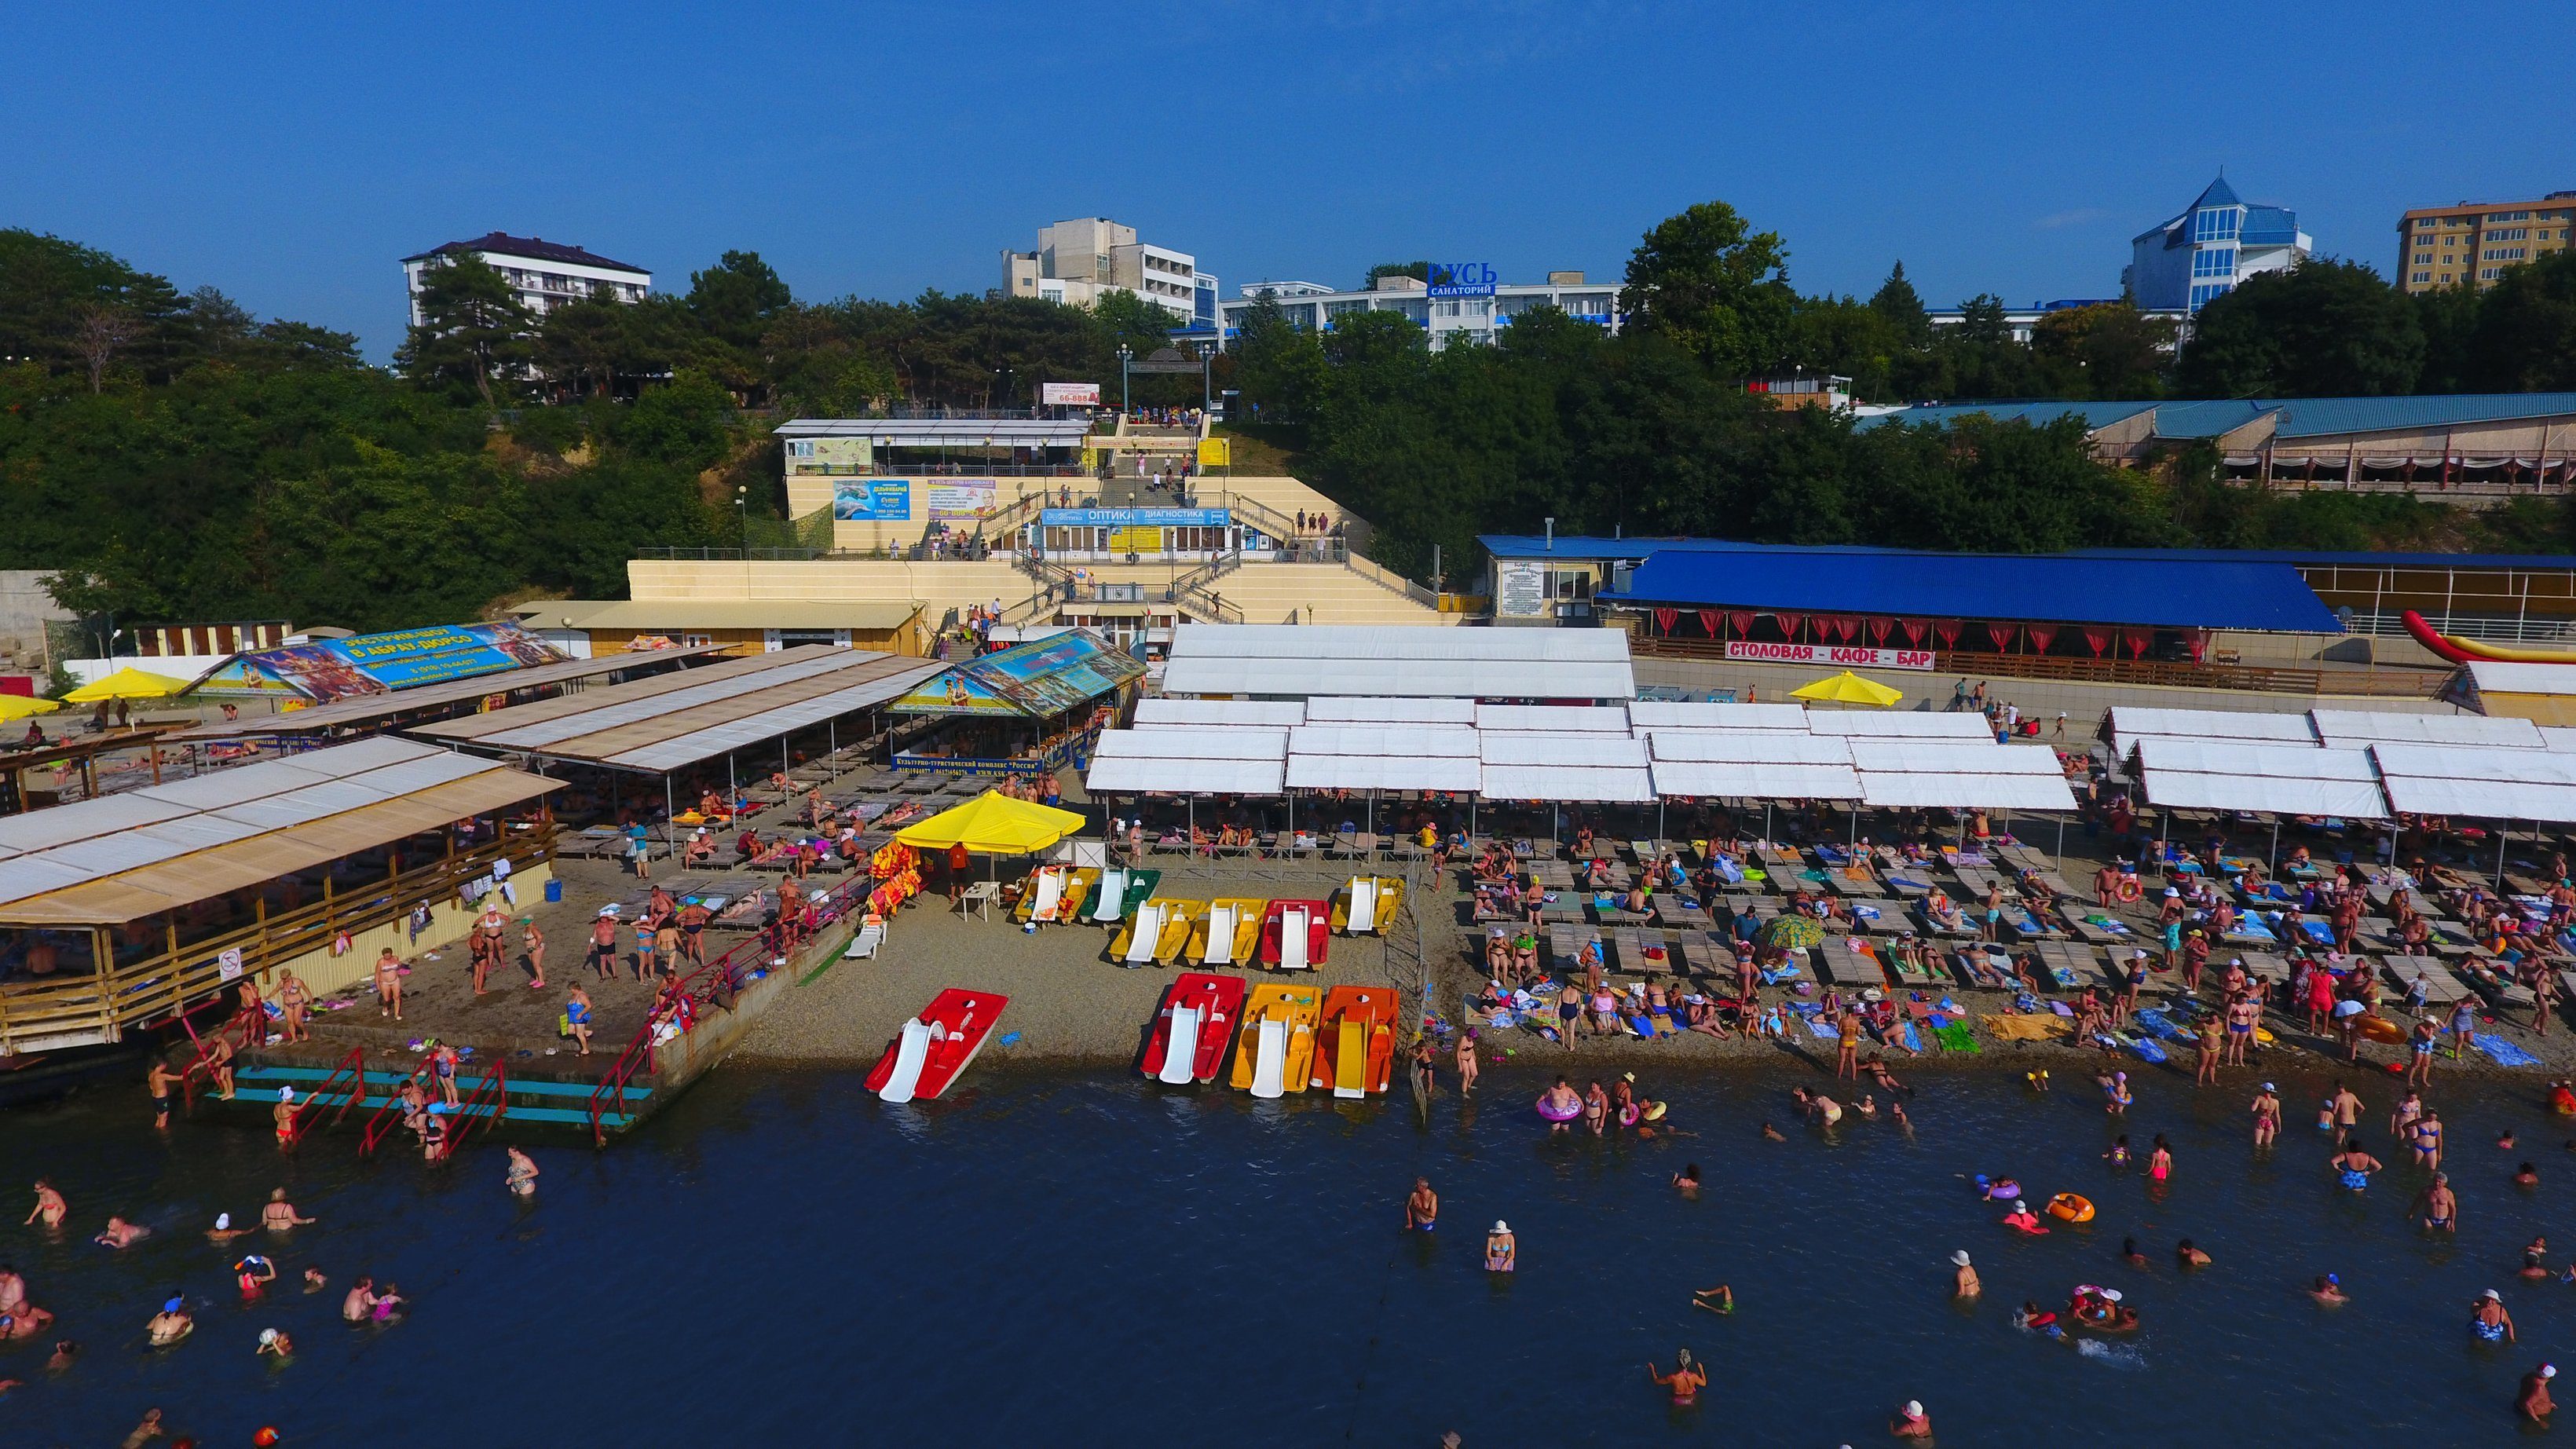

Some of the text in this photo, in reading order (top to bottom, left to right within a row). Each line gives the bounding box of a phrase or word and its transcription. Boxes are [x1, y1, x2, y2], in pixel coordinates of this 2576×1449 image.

[1428, 263, 1497, 285] РУСЬ
[1431, 284, 1491, 295] САНАТОРИЙ
[1089, 510, 1135, 520] ОПТИКА
[342, 628, 449, 646] ЭКСТРИМ-ШОУ
[349, 635, 473, 658] В АБРАУ-ДЮРСО
[1729, 642, 1813, 659] СТОЛОВАЯ
[1831, 648, 1879, 663] КАФЕ
[1897, 651, 1930, 666] БАР
